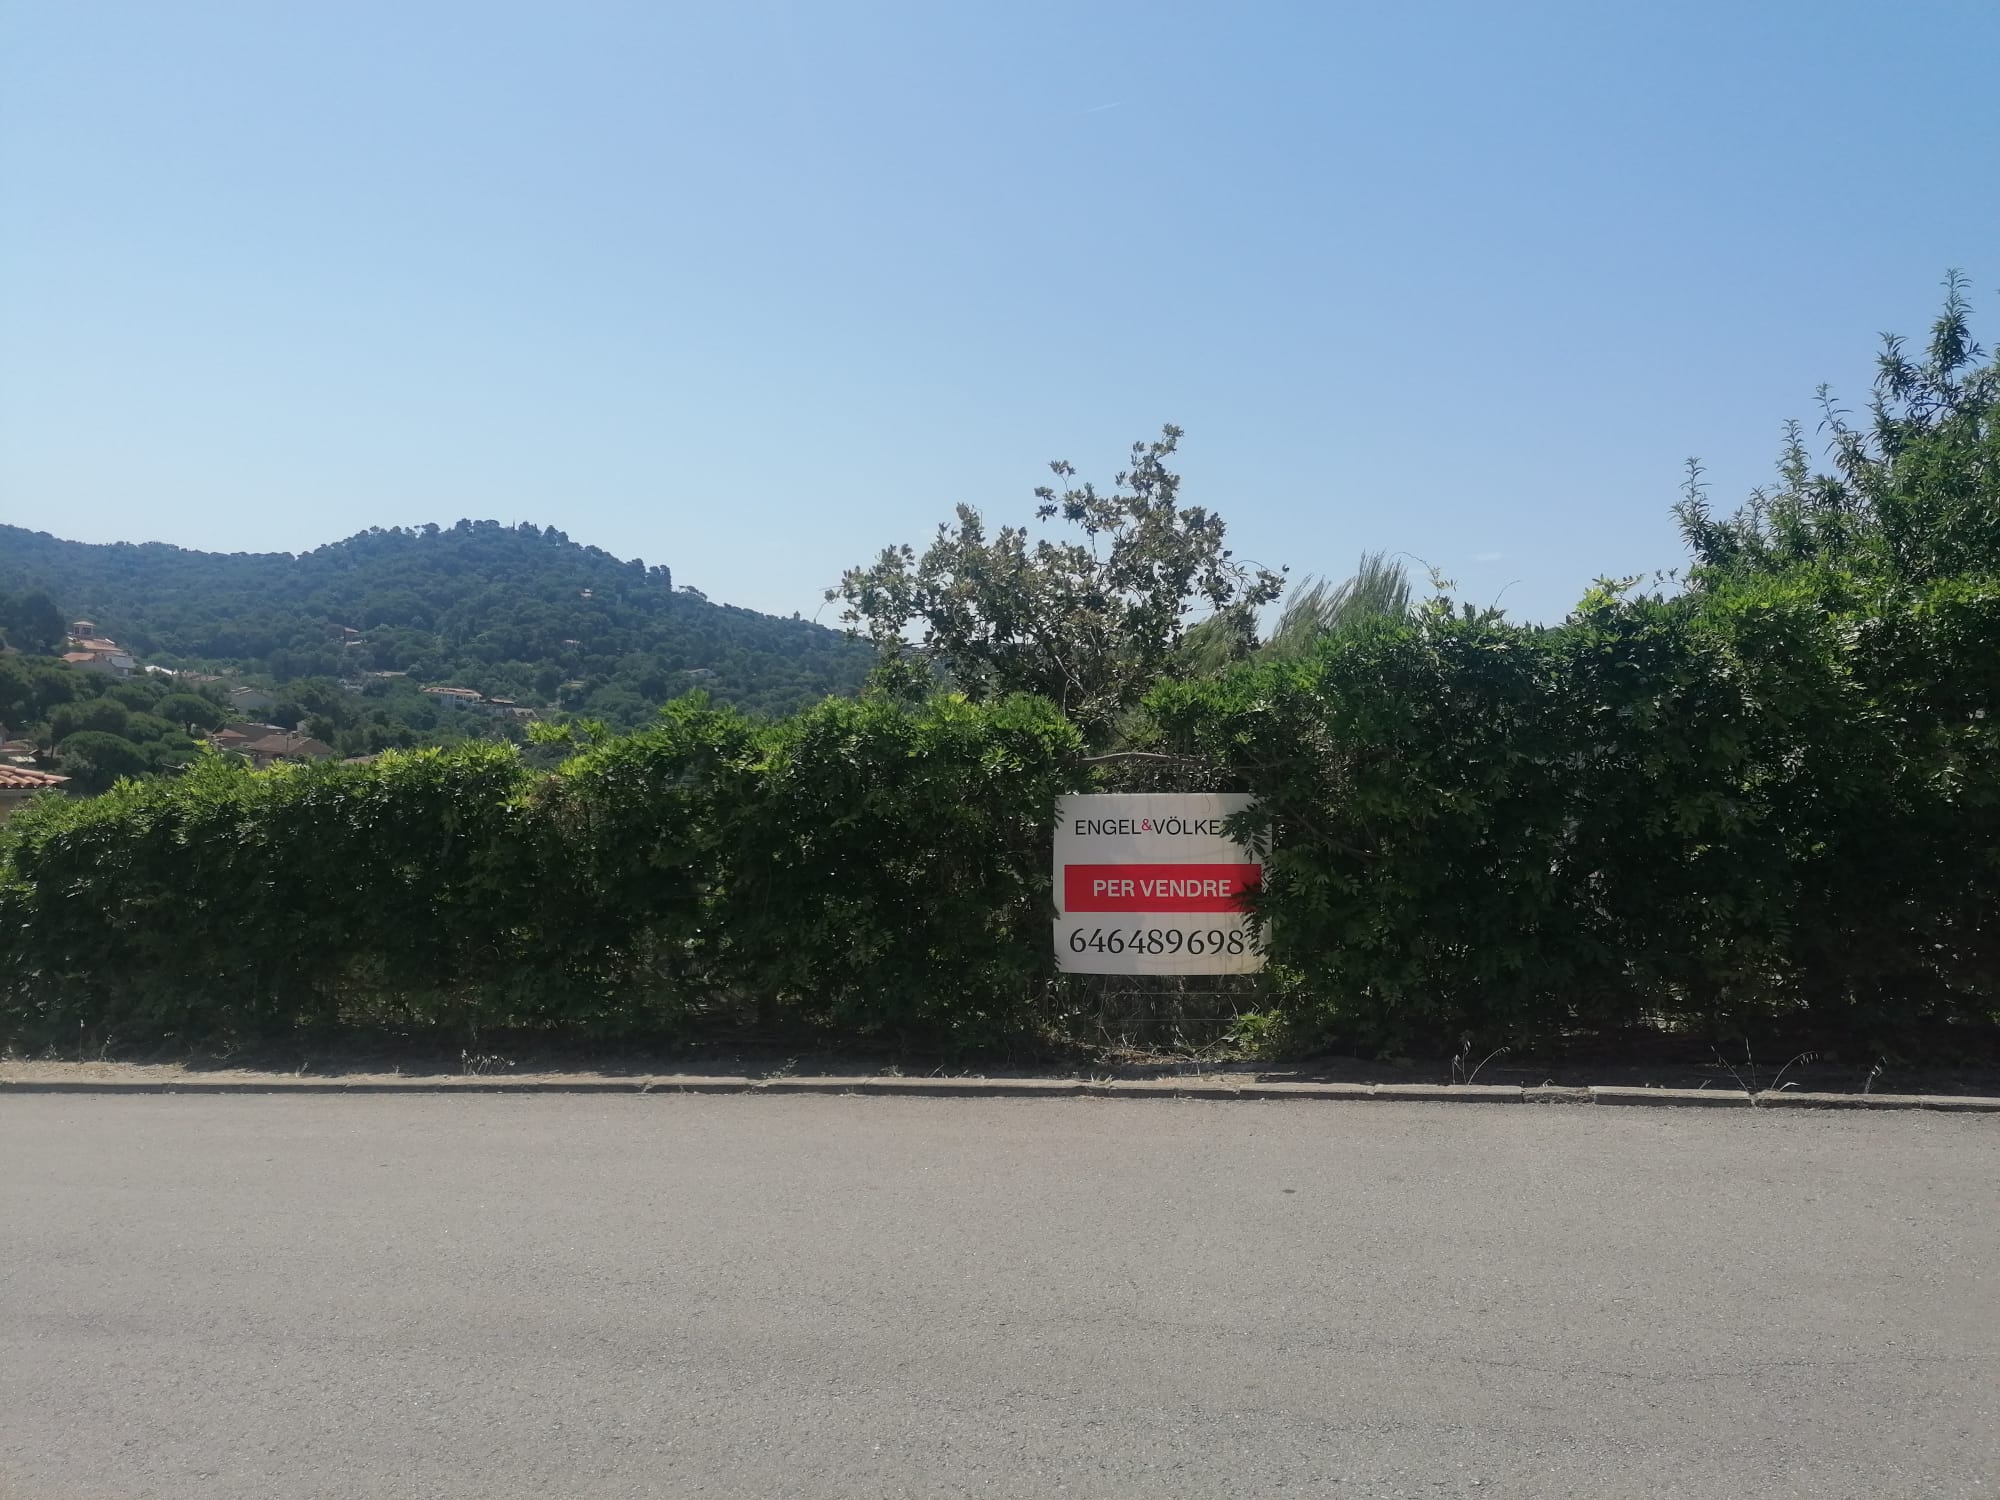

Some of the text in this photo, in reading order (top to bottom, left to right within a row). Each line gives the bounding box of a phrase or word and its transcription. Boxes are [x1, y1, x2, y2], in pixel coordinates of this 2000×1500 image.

[1075, 816, 1221, 836] ENGEL&VÖLKE
[1093, 879, 1232, 898] PER VENDRE
